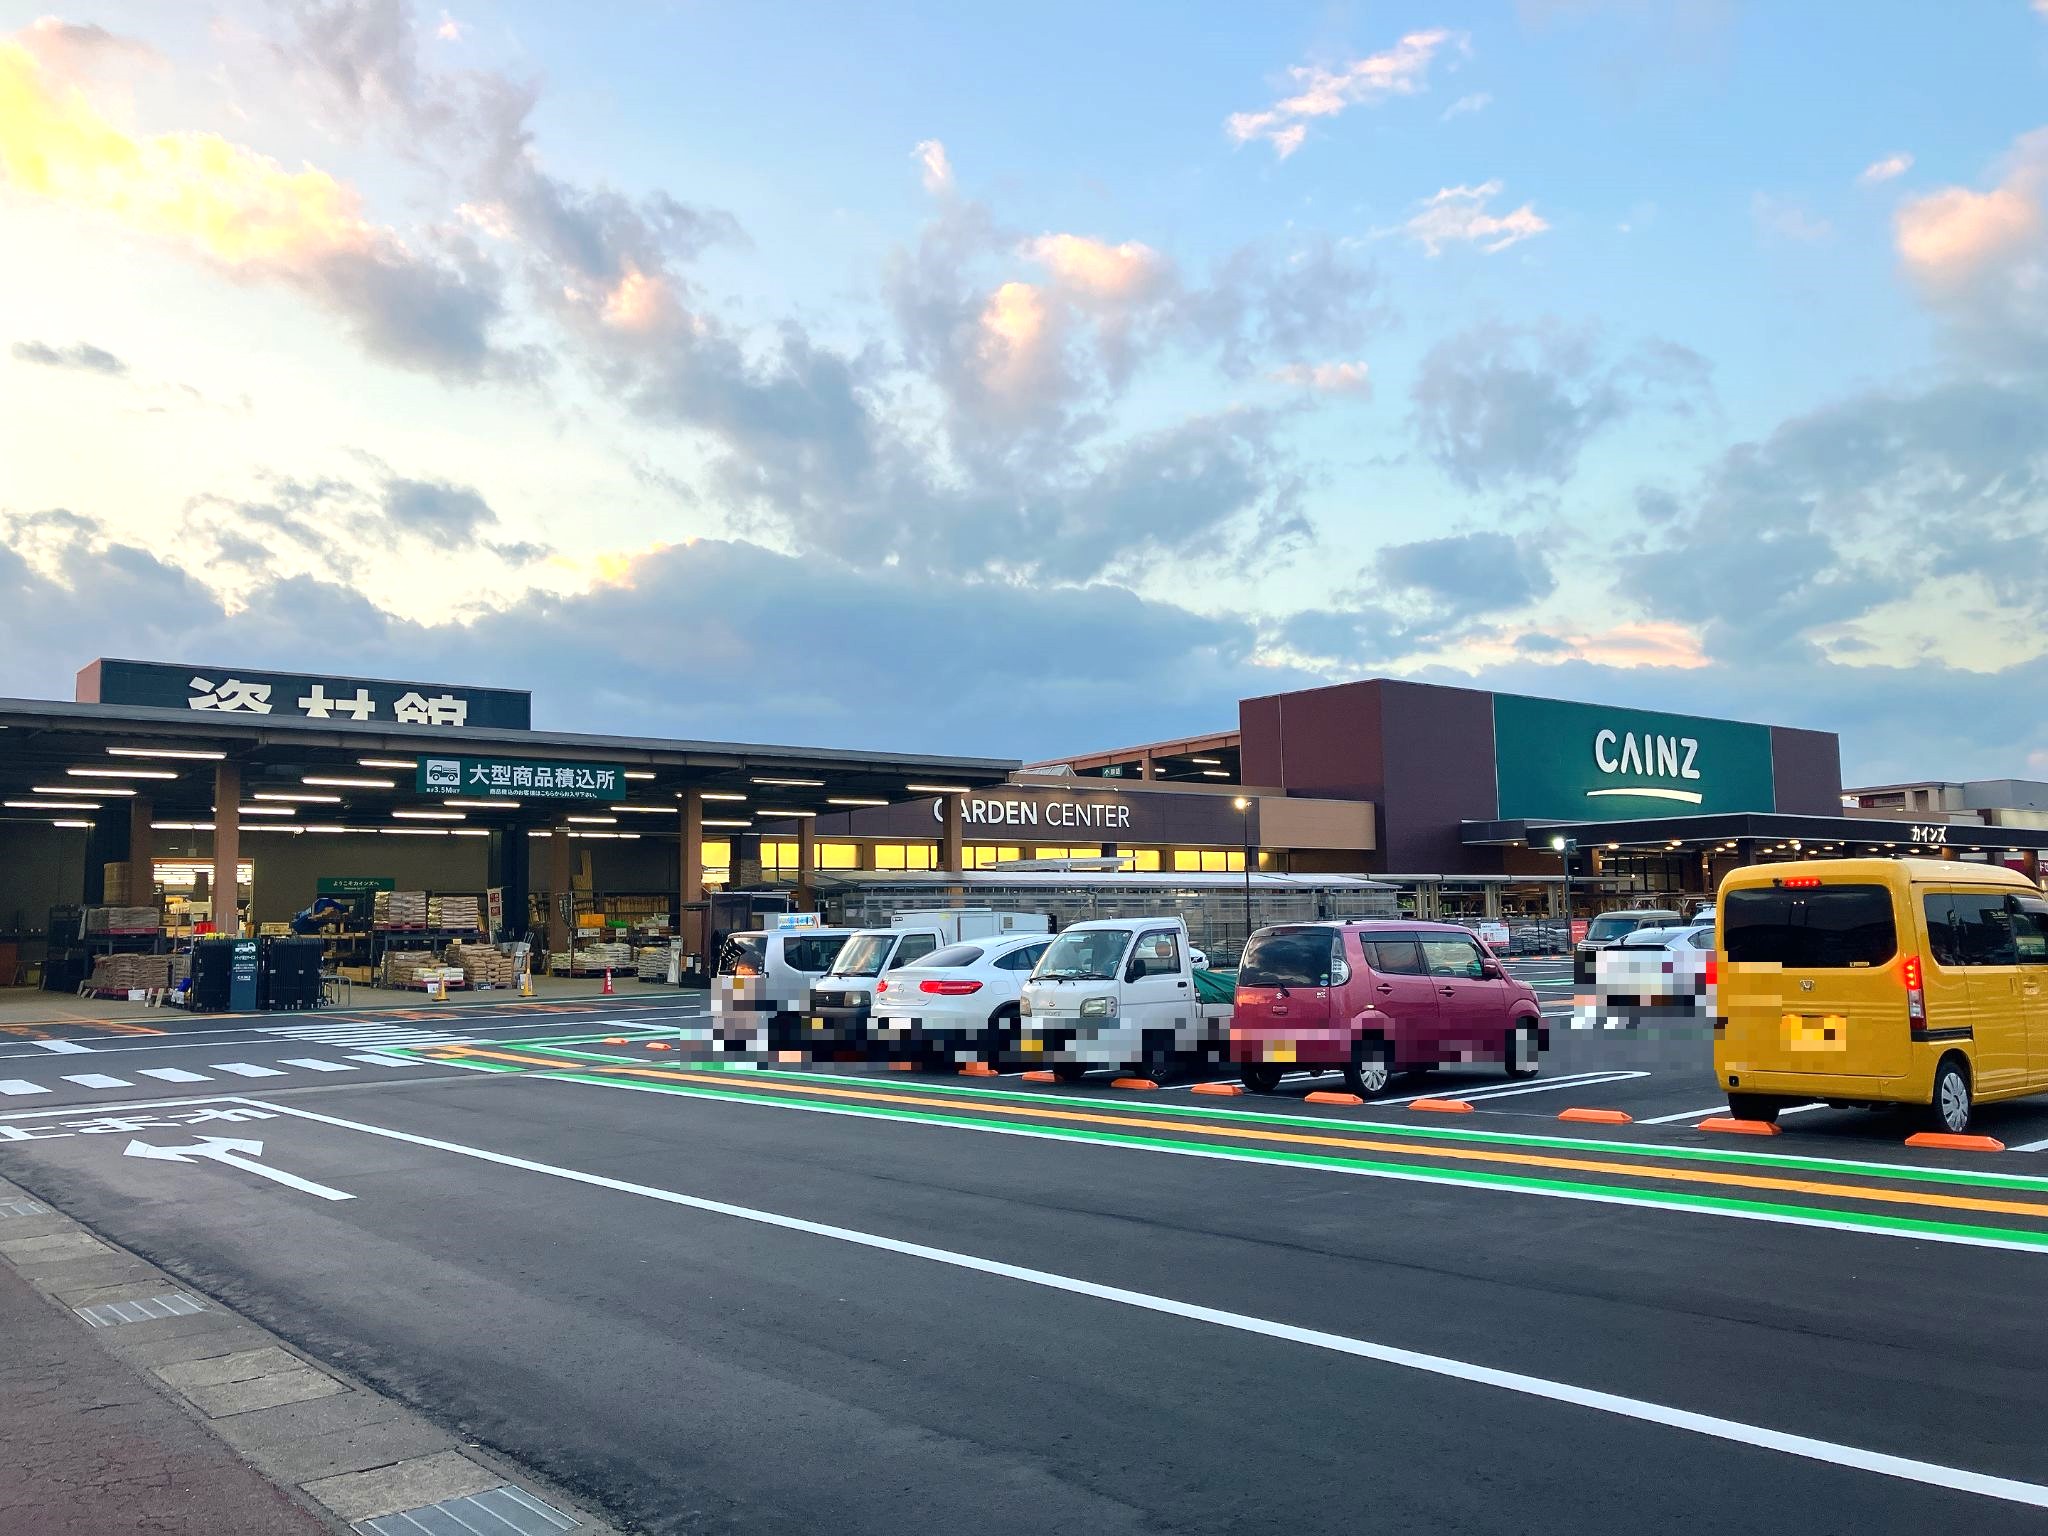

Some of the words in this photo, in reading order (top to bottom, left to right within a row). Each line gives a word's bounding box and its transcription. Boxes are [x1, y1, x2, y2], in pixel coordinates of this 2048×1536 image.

[1595, 729, 1700, 779] CAINZ
[468, 763, 615, 790] 大型商品積込所
[1045, 802, 1130, 828] CENTER
[1911, 825, 1947, 843] カインズ
